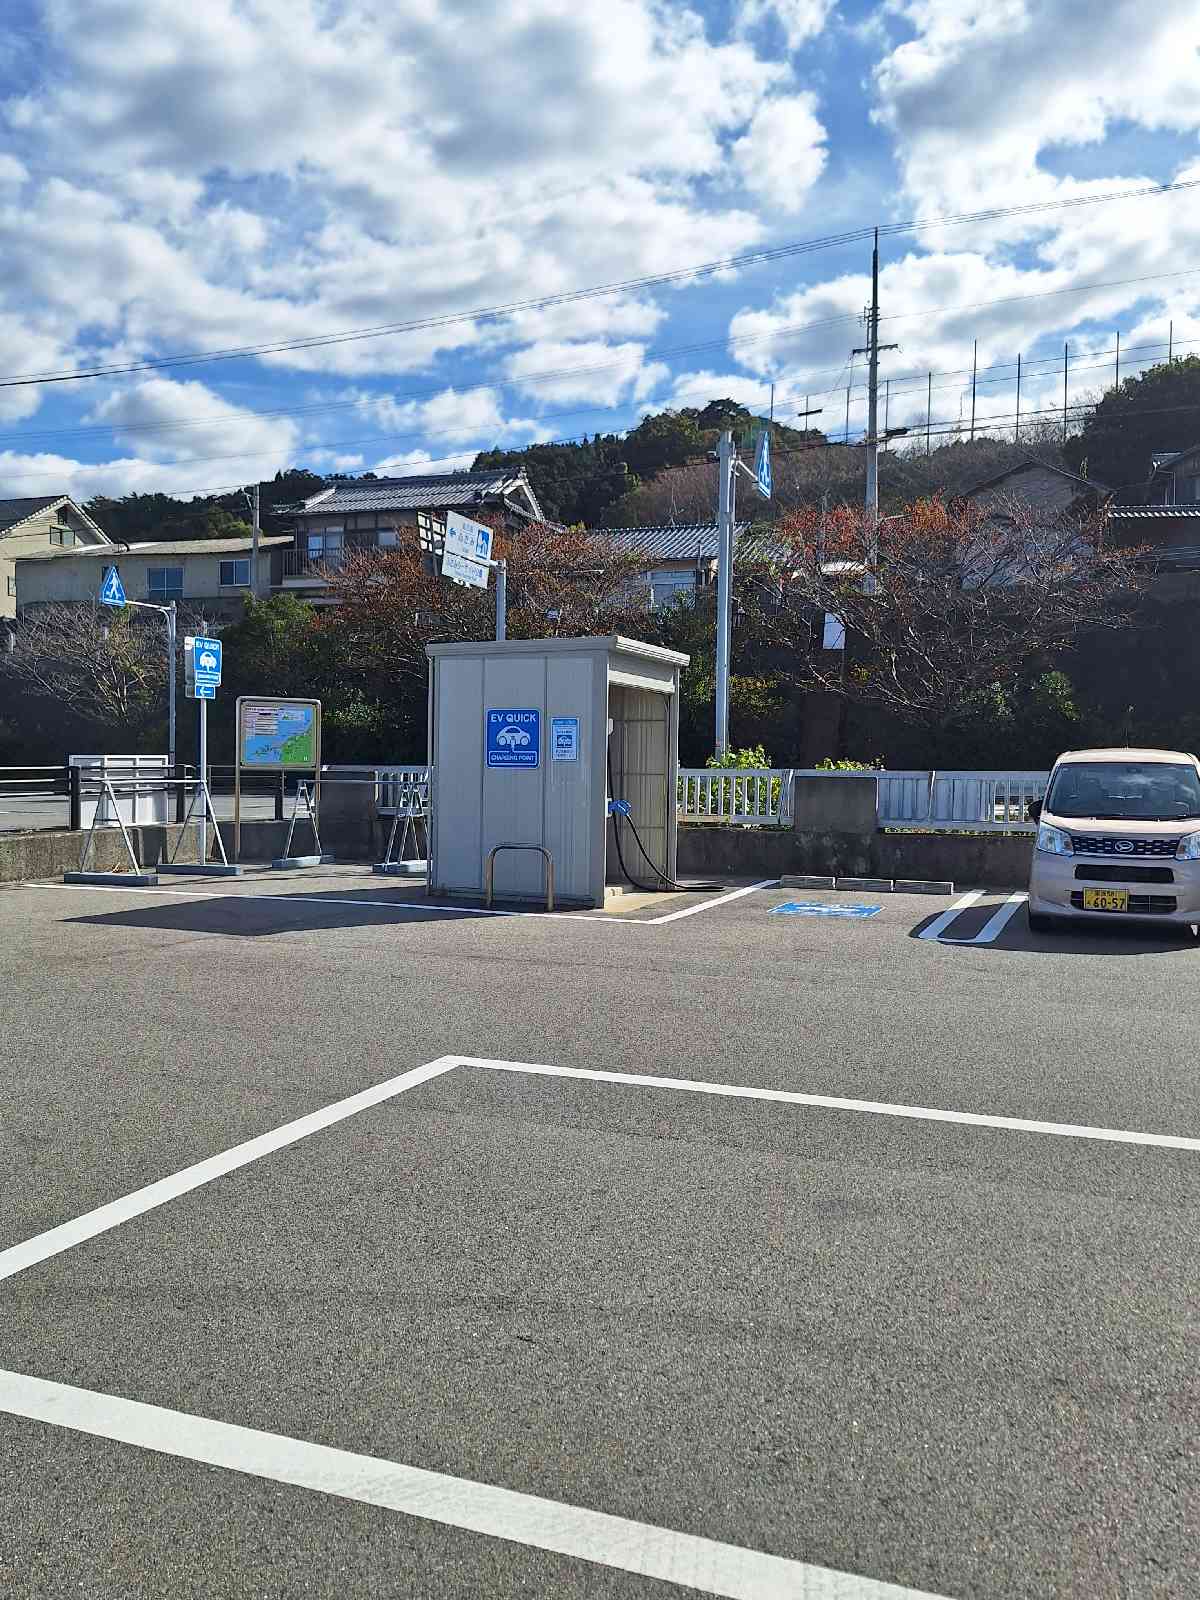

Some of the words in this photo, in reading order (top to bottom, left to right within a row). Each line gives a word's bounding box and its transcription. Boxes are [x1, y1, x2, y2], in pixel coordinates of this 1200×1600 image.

[490, 713, 504, 722] EV
[505, 713, 537, 723] QUICK
[1094, 897, 1125, 909] 60-57
